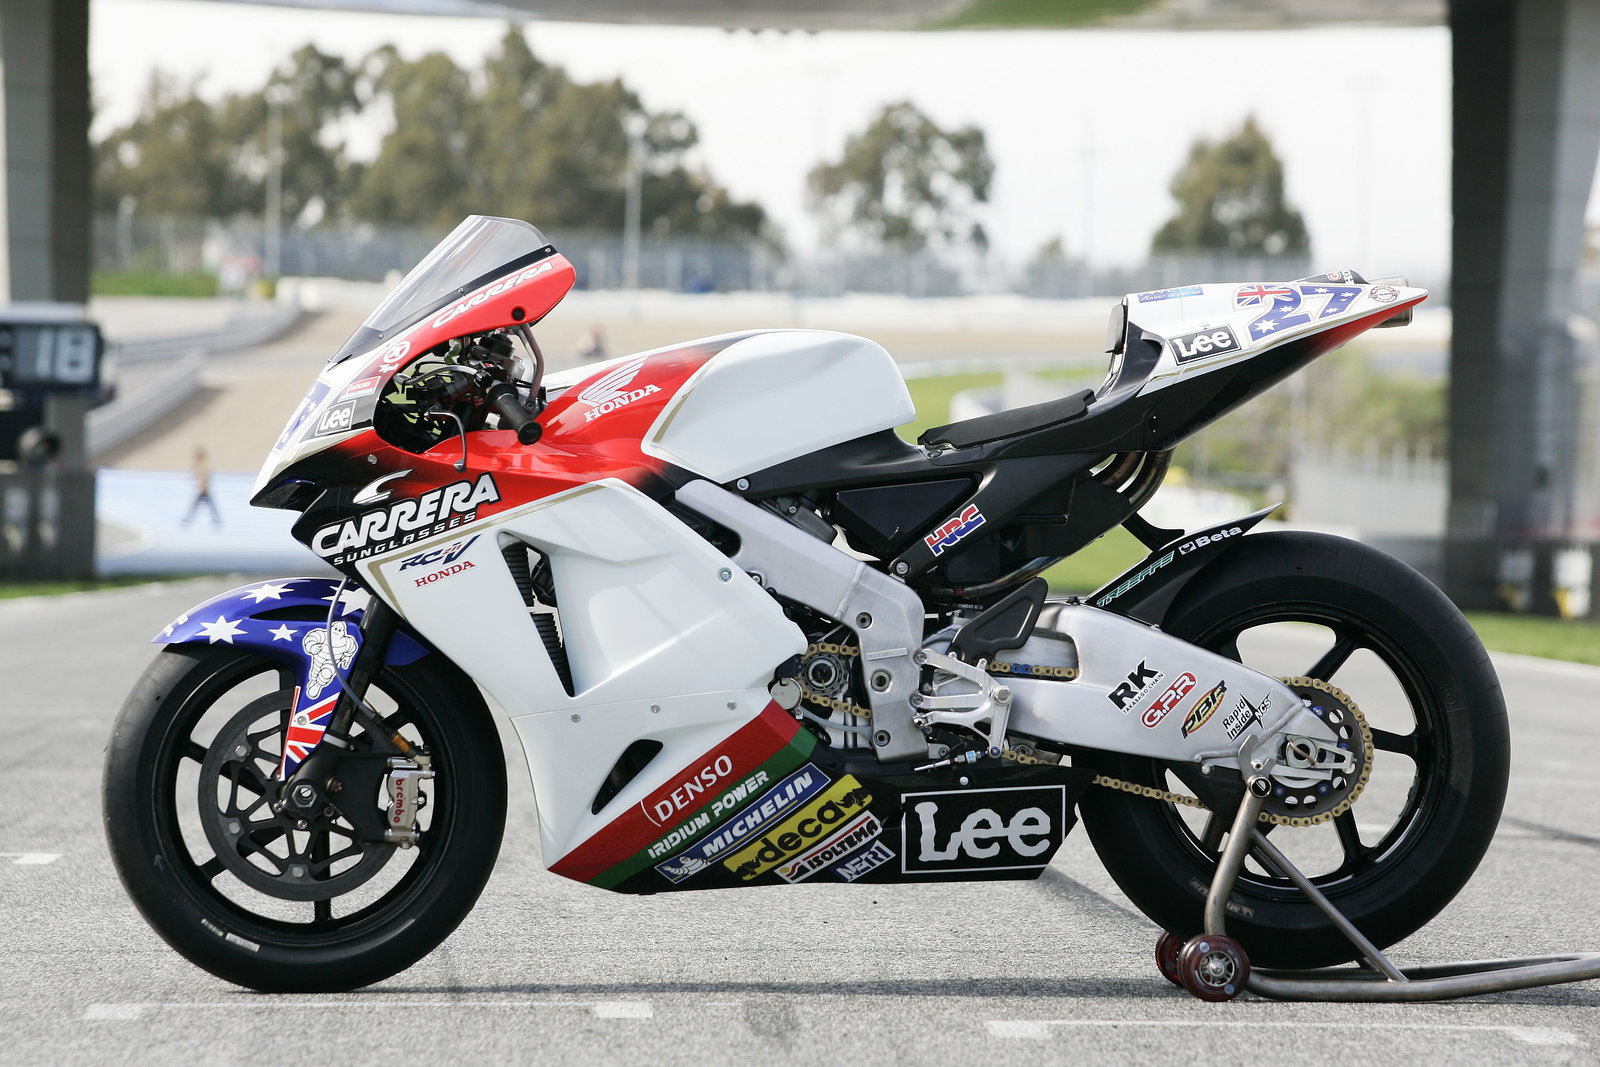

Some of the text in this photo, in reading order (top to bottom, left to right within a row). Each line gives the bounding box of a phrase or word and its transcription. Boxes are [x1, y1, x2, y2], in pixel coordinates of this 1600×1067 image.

[432, 261, 552, 329] CARRERA
[1234, 283, 1363, 343] 27
[1173, 331, 1232, 358] Lee
[319, 407, 351, 431] Lee
[584, 384, 662, 423] HONDA
[311, 474, 499, 558] CARRERA
[334, 511, 477, 566] SUNGLASSES
[924, 503, 986, 557] HRC
[1196, 526, 1243, 548] Beta
[414, 561, 476, 588] HONDA
[1108, 659, 1159, 710] RK
[1148, 672, 1165, 690] CHAIN
[1223, 699, 1246, 730] Rapid
[1227, 697, 1273, 741] Inside NCS
[393, 778, 405, 823] brembo
[654, 754, 733, 823] DENSO
[648, 770, 769, 859] IRIDIUM POWER
[702, 771, 813, 857] MICHELIN
[757, 800, 847, 862] deca
[914, 801, 1051, 862] Lee
[807, 819, 879, 869] ISOLTEMA
[836, 846, 892, 880] NERI
